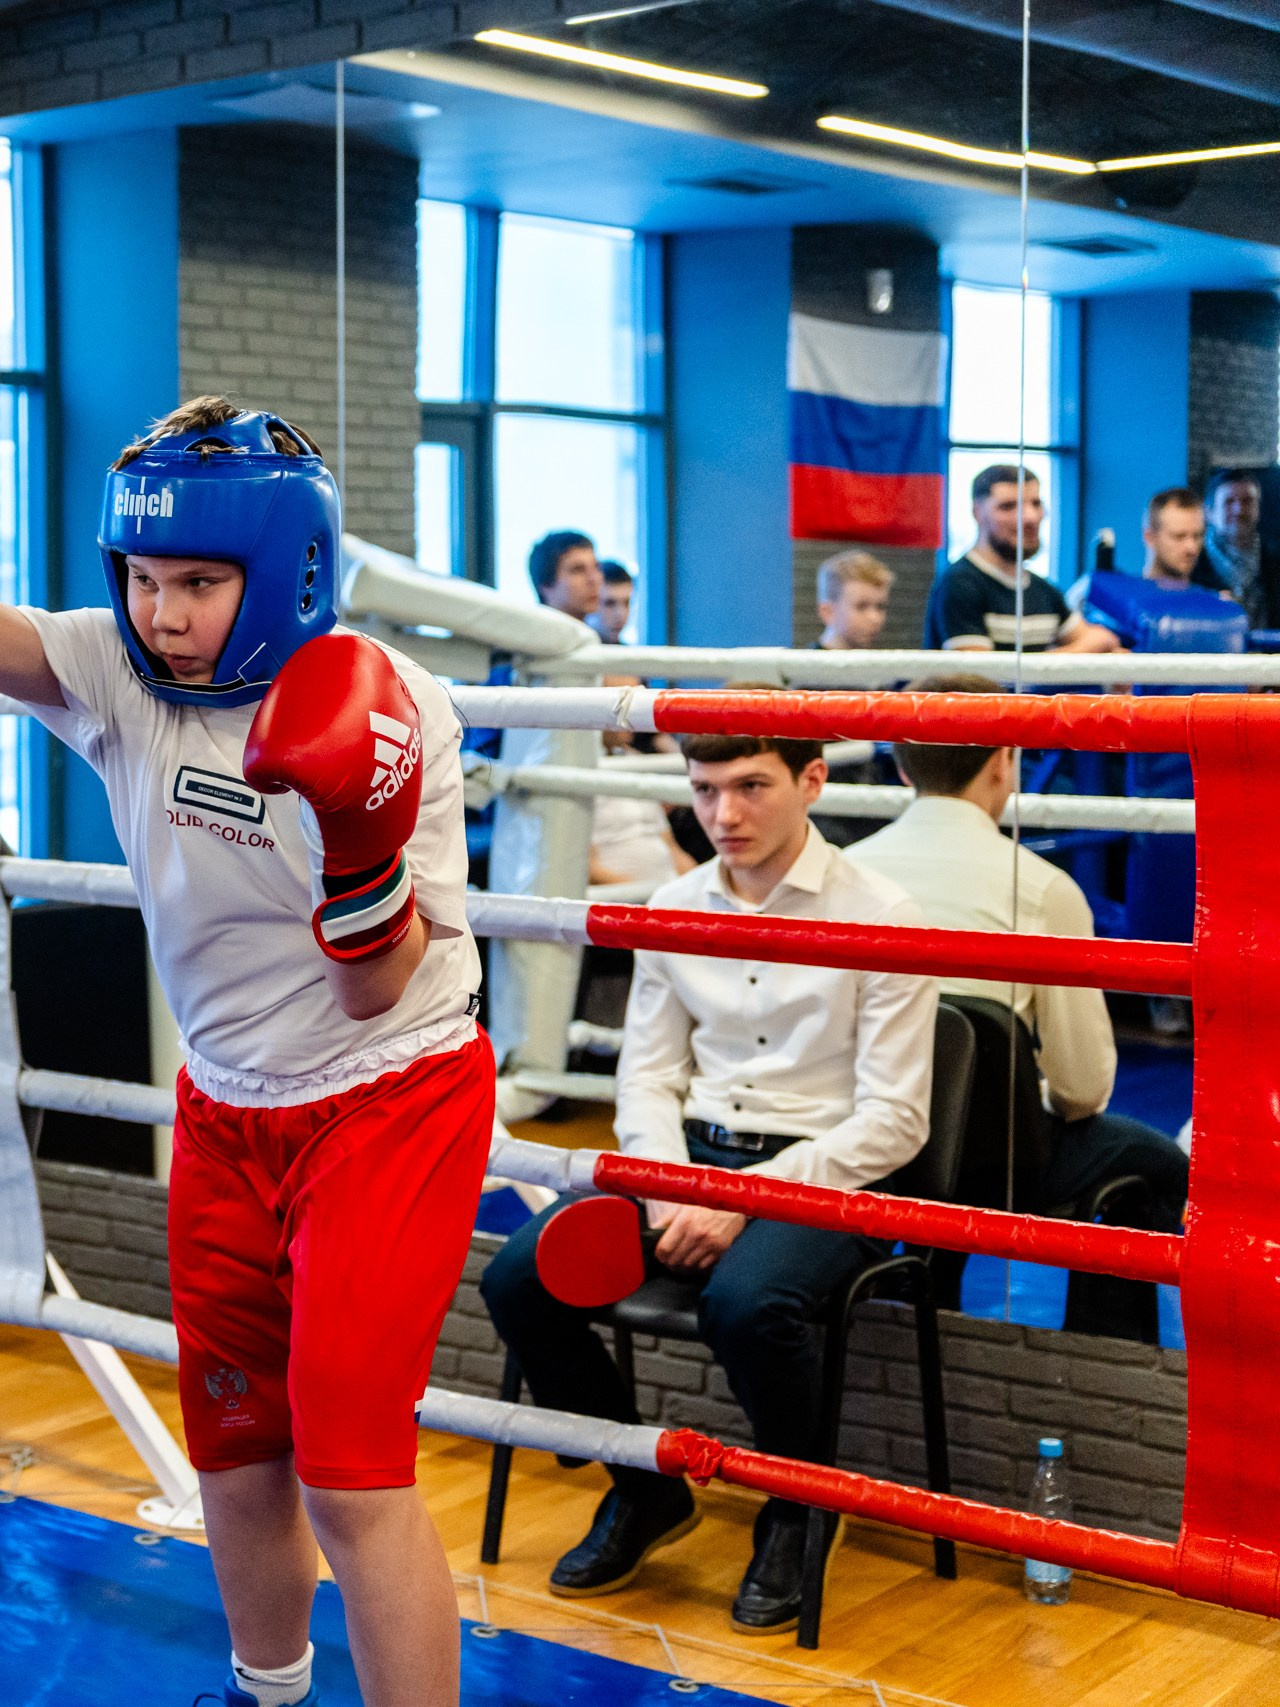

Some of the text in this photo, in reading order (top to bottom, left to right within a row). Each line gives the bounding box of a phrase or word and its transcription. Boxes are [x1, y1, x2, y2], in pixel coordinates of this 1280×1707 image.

[114, 487, 174, 517] clinch
[365, 727, 421, 811] adidas
[208, 822, 275, 853] COLOR
